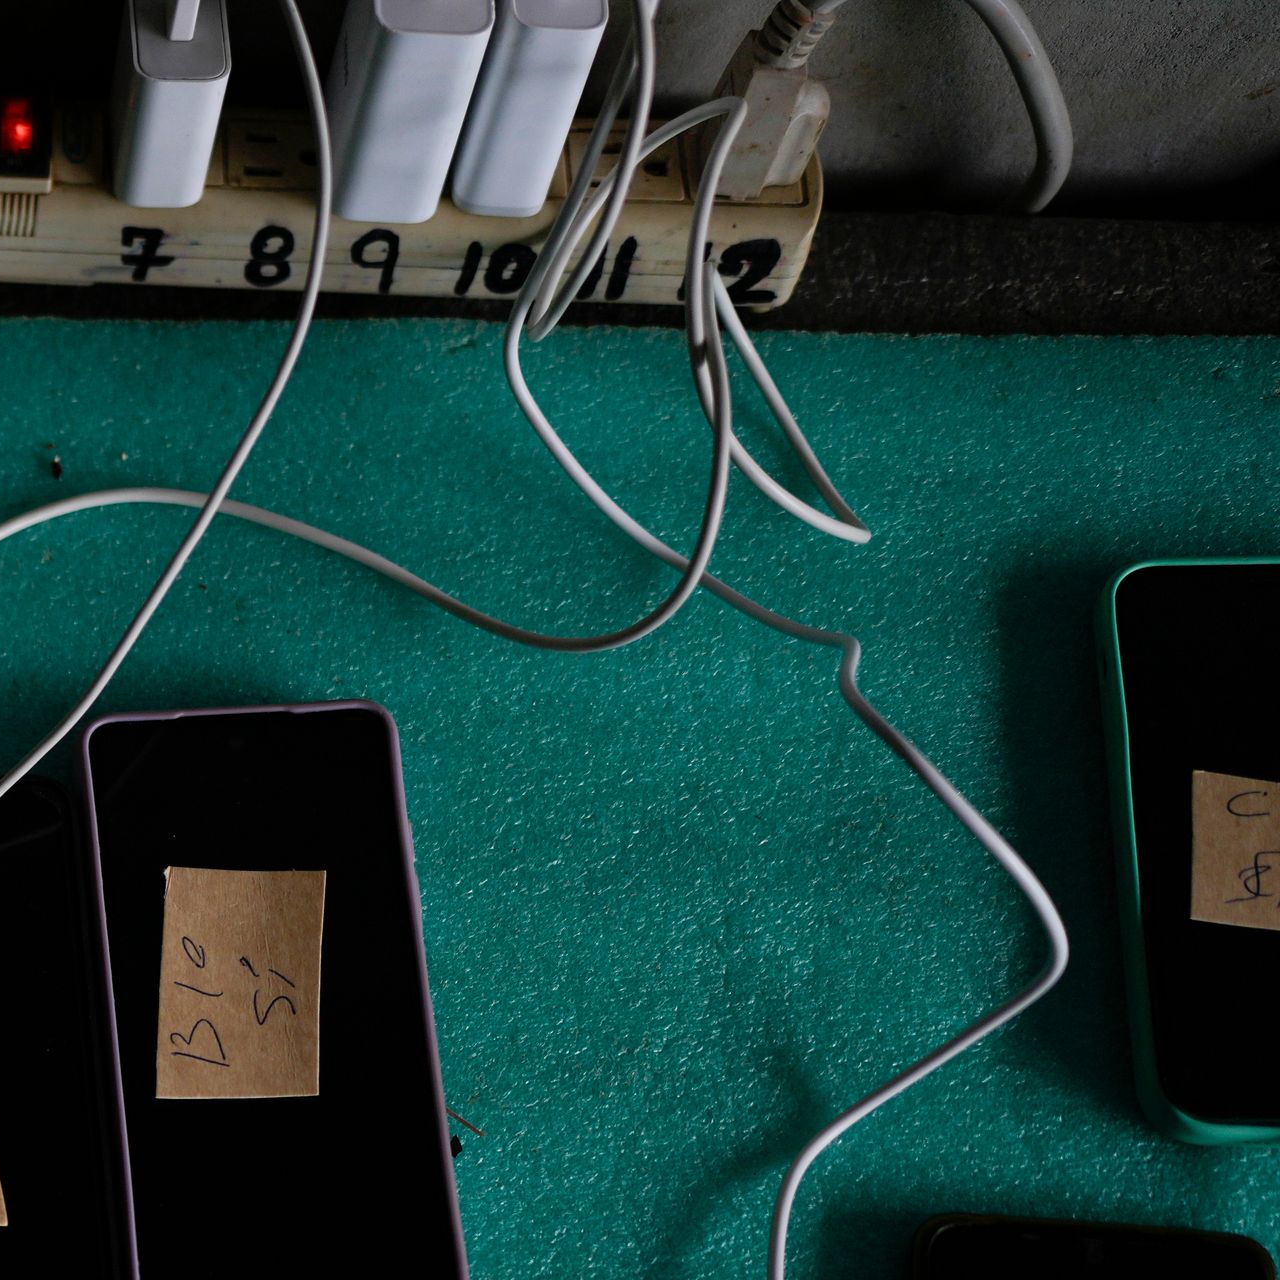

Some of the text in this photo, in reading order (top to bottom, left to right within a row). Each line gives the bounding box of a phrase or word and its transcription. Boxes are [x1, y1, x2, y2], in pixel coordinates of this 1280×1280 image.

[120, 225, 175, 282] 7
[243, 224, 295, 287] 8
[351, 228, 400, 296] 9
[454, 241, 540, 296] 10
